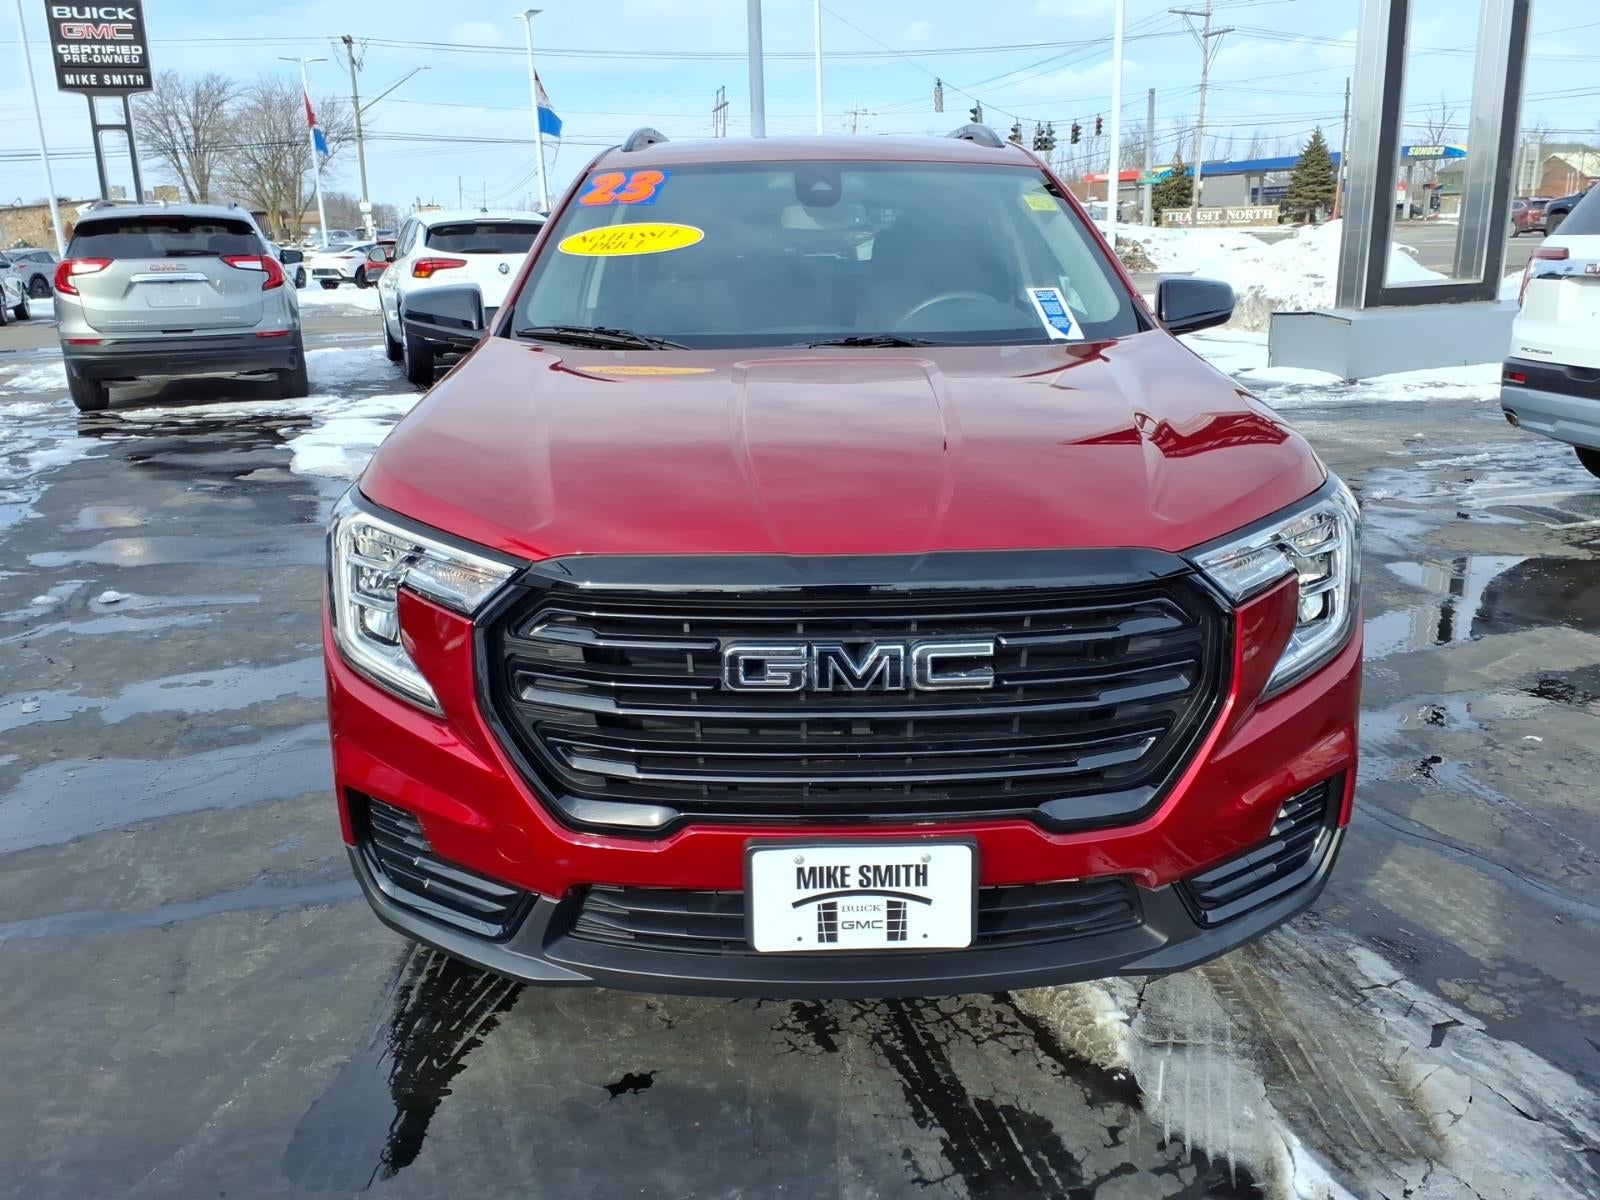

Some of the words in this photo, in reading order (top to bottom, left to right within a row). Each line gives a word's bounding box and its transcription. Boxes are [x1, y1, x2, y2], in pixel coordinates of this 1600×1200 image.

[52, 6, 137, 20] BUICK
[61, 23, 134, 40] GMC
[57, 44, 143, 55] CERTIFIED
[63, 54, 139, 63] PRE-OWNED
[65, 74, 98, 85] MIKE
[103, 74, 144, 85] SMITH
[1407, 146, 1445, 156] SUNOCO
[579, 170, 665, 206] 23
[1227, 209, 1273, 220] NORTH
[722, 638, 995, 693] GMC
[796, 865, 851, 889] MIKE
[858, 863, 928, 888] SMITH
[841, 904, 883, 913] BUICK
[841, 919, 884, 930] GMC
